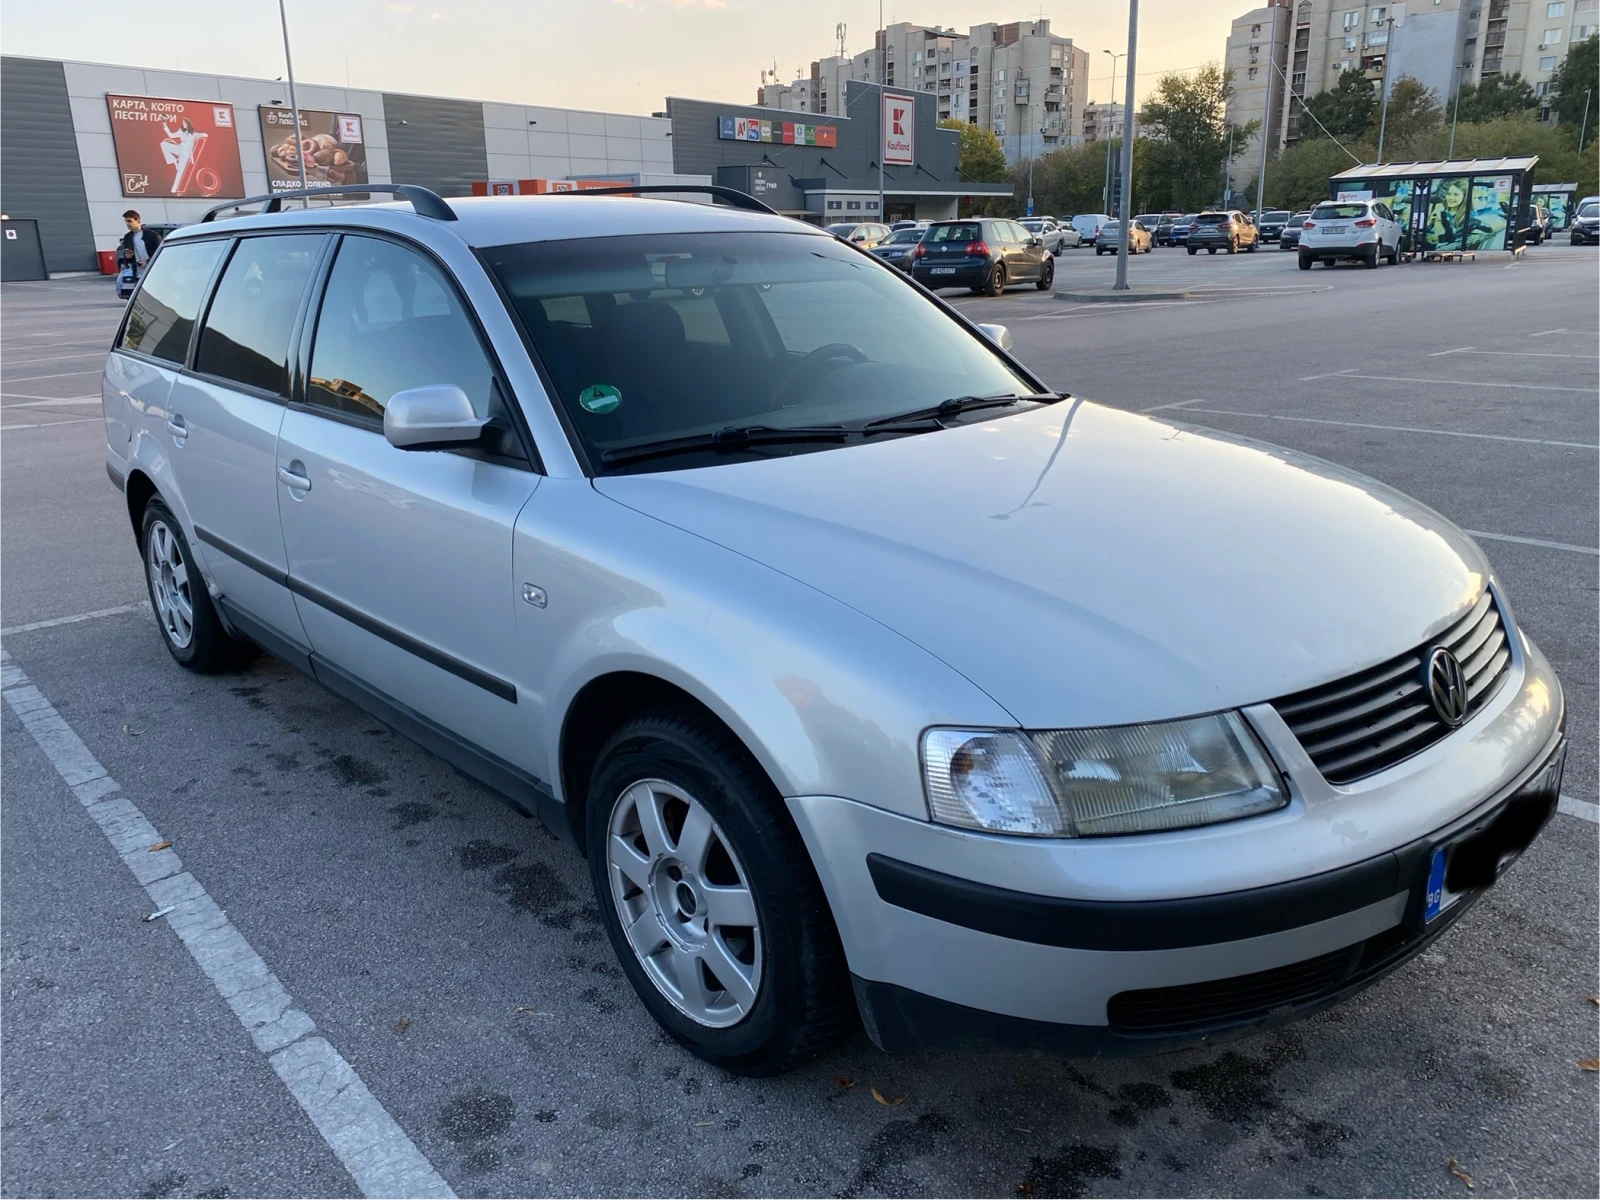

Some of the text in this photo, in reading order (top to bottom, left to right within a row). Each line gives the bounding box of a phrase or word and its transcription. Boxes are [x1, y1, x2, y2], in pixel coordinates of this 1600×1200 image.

[112, 99, 184, 113] КАРТА, КОЯТО
[114, 110, 147, 121] ПЕСТИ
[893, 108, 905, 135] K
[737, 120, 746, 136] A1
[887, 140, 910, 151] Kaufland
[128, 175, 149, 191] Card
[271, 180, 302, 188] СЛАДКО
[593, 386, 605, 398] 4
[1427, 889, 1441, 908] BG
